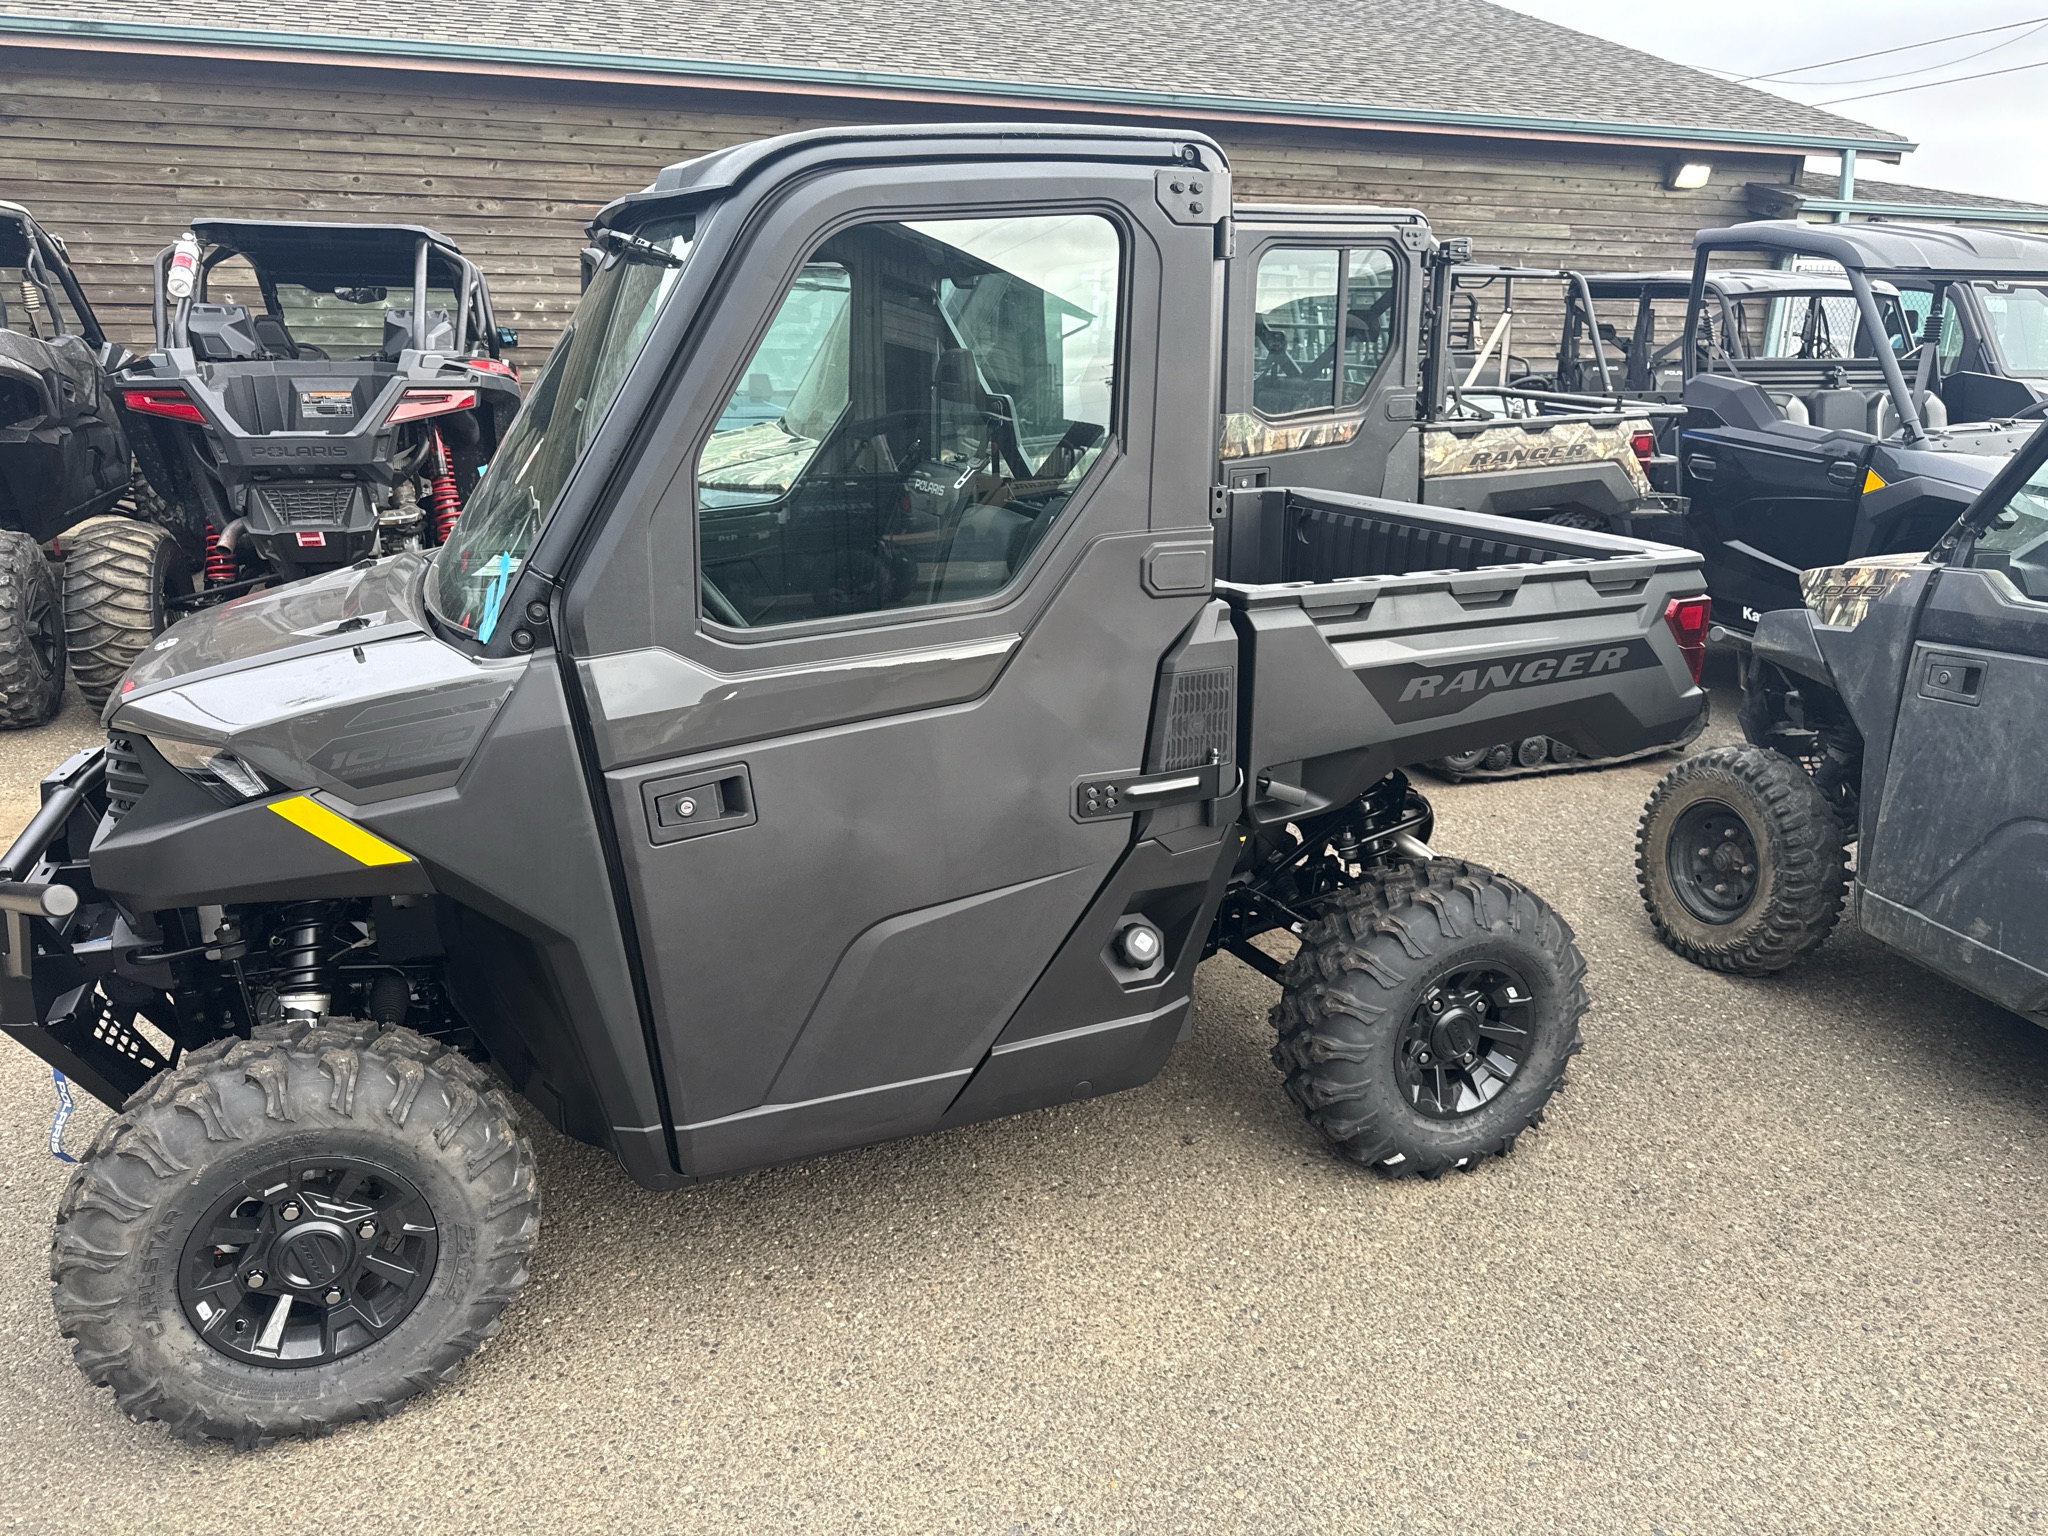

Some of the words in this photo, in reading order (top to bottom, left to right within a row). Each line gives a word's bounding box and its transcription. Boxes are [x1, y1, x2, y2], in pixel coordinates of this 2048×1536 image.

[250, 446, 348, 457] POLARIS
[1469, 444, 1587, 467] RANGER
[914, 478, 946, 497] POLARIS
[1817, 584, 1888, 597] 1000
[1743, 606, 1762, 622] Ka
[1398, 647, 1629, 702] RANGER
[330, 725, 476, 770] 1000
[51, 1081, 73, 1154] POLARIS
[139, 1209, 184, 1340] CARLSTAR
